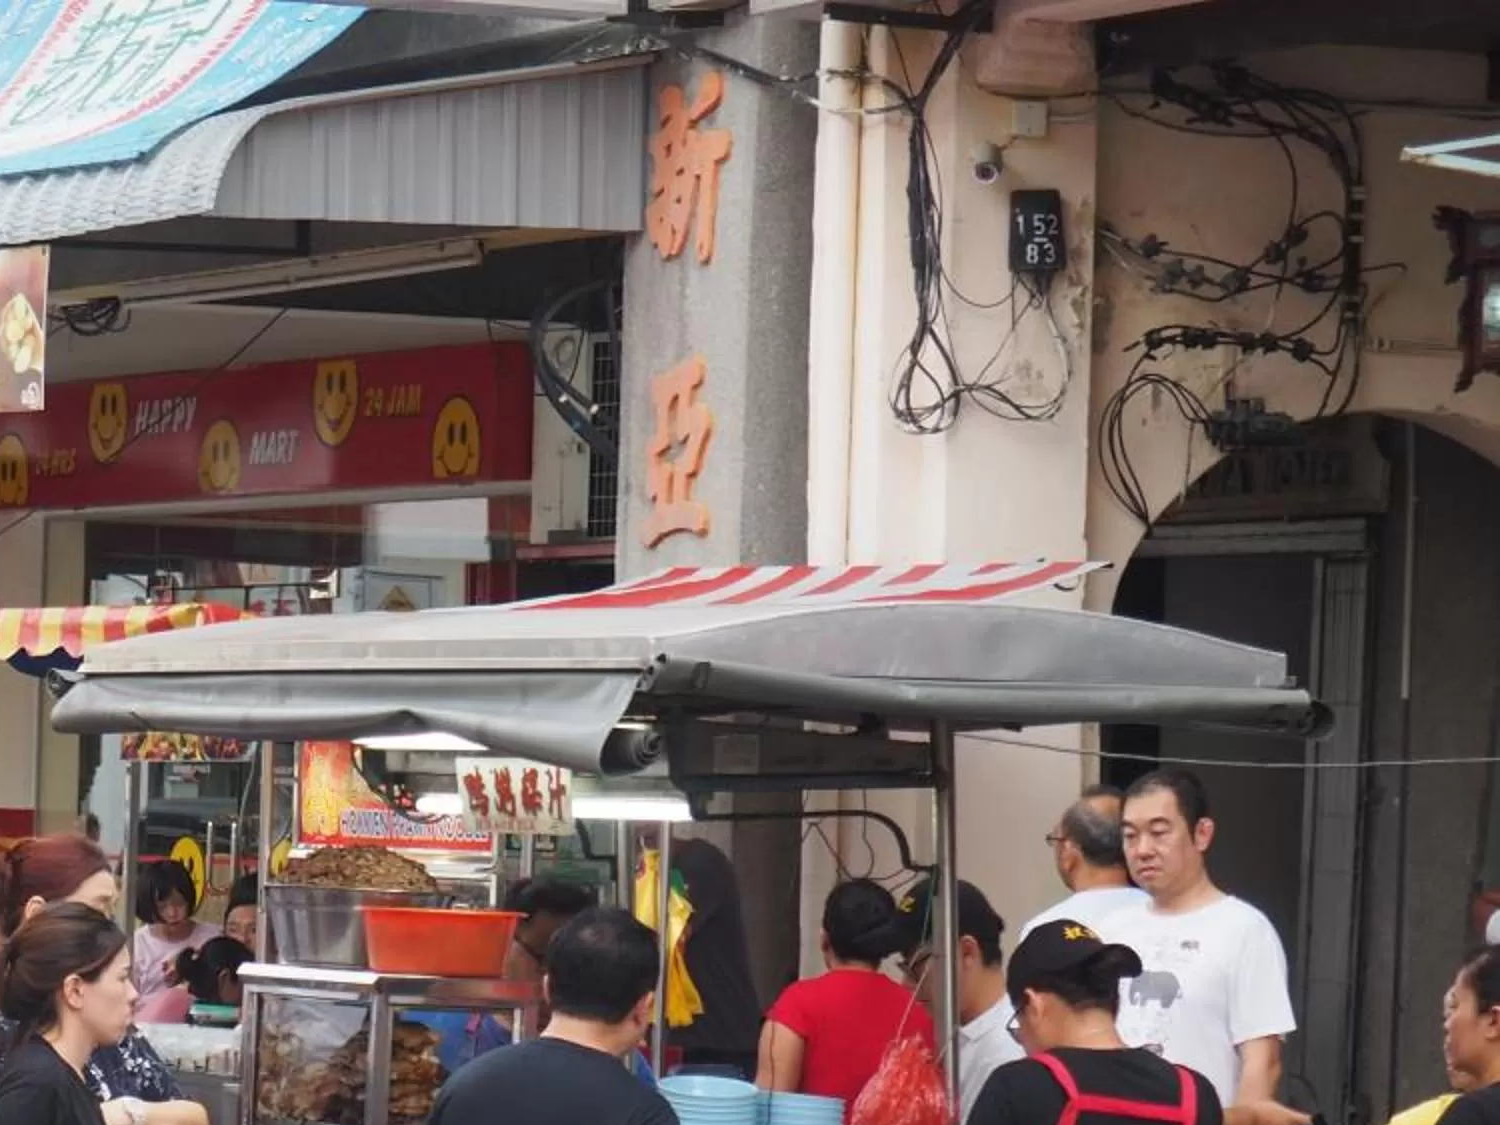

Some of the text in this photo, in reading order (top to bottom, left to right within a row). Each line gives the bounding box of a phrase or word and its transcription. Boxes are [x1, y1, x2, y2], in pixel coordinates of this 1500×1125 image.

[1026, 243, 1056, 264] 83
[134, 395, 198, 436] HAPPY
[364, 383, 422, 418] 24 JAM
[248, 429, 299, 466] MART
